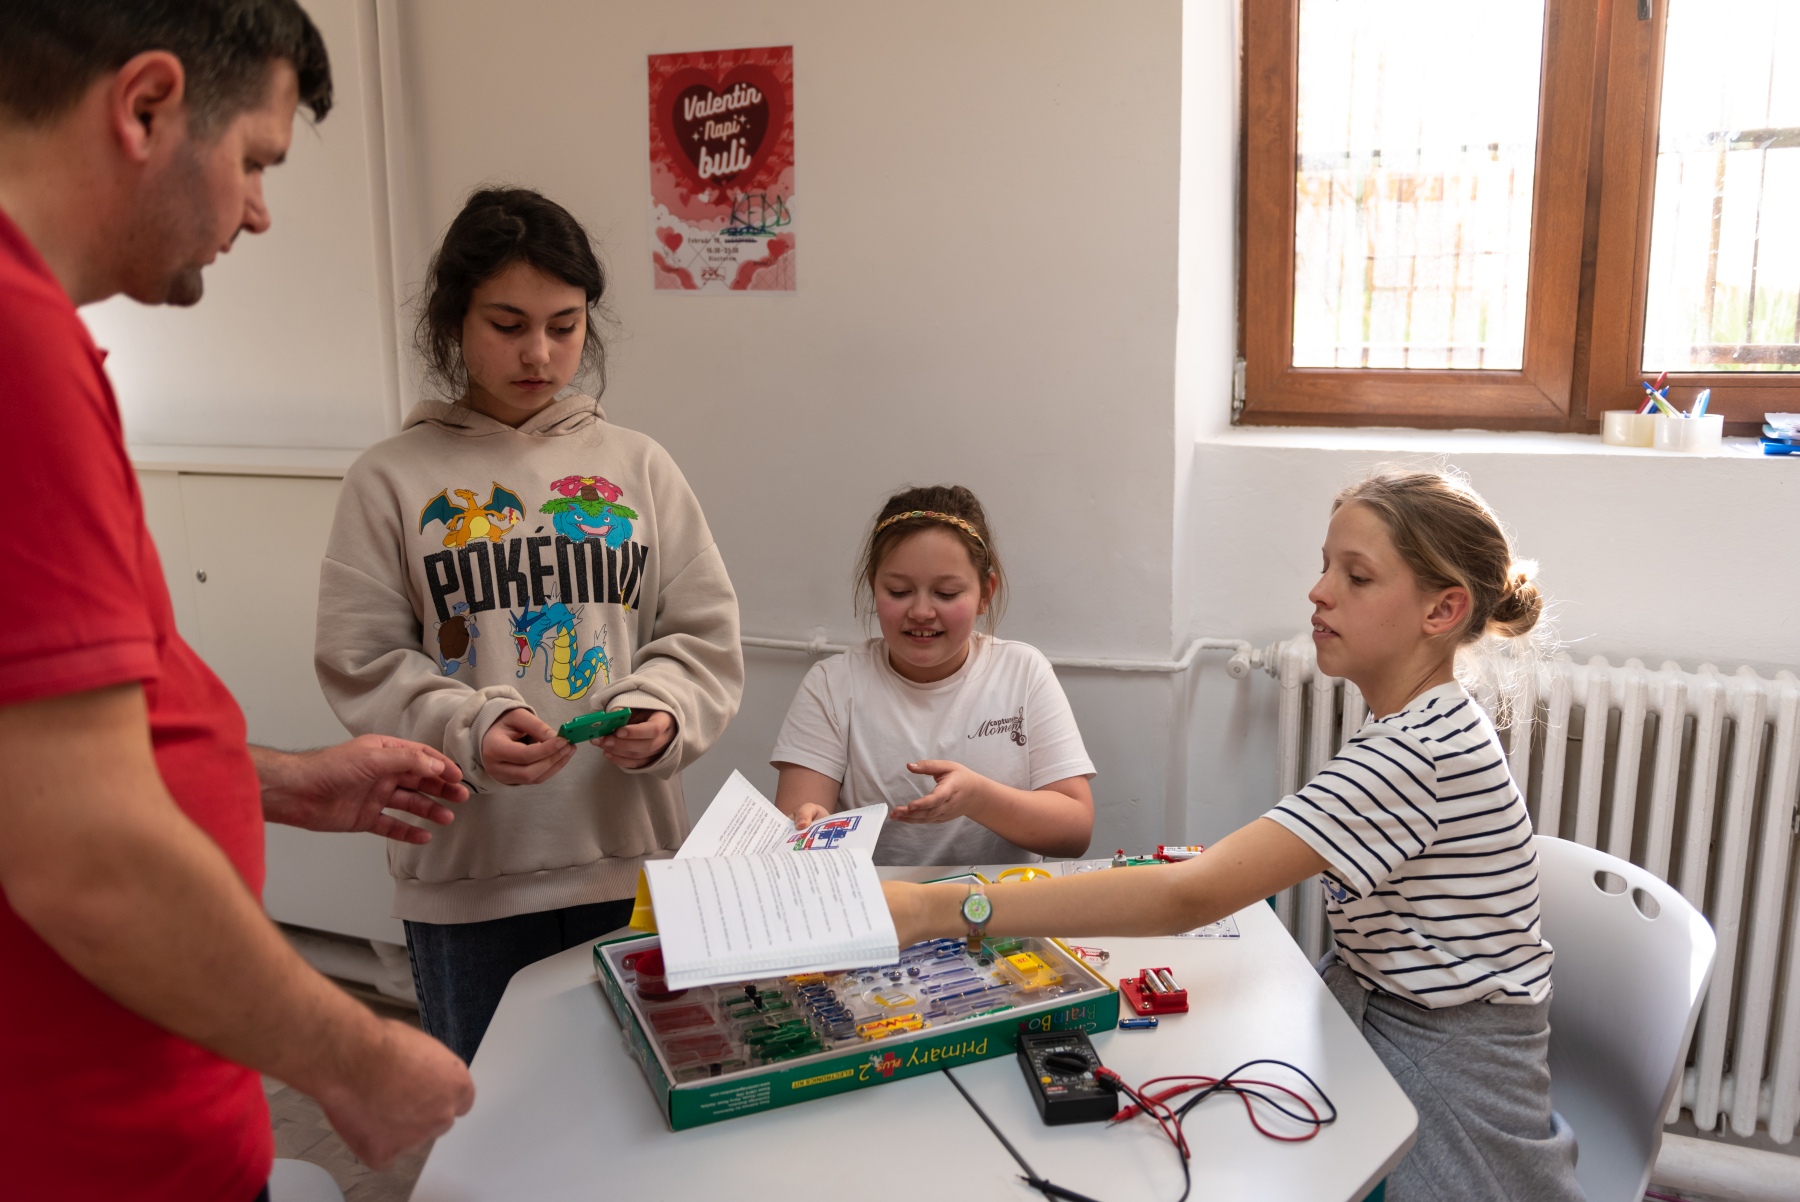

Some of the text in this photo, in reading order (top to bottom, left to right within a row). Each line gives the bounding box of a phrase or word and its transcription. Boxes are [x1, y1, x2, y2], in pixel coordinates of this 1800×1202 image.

[684, 83, 762, 121] Valentin
[704, 115, 741, 141] Napi
[699, 137, 752, 179] buli
[1018, 1004, 1096, 1033] BrainBox
[858, 1038, 988, 1082] Primary PLUS 2
[805, 1070, 853, 1086] ELECTRONICS
